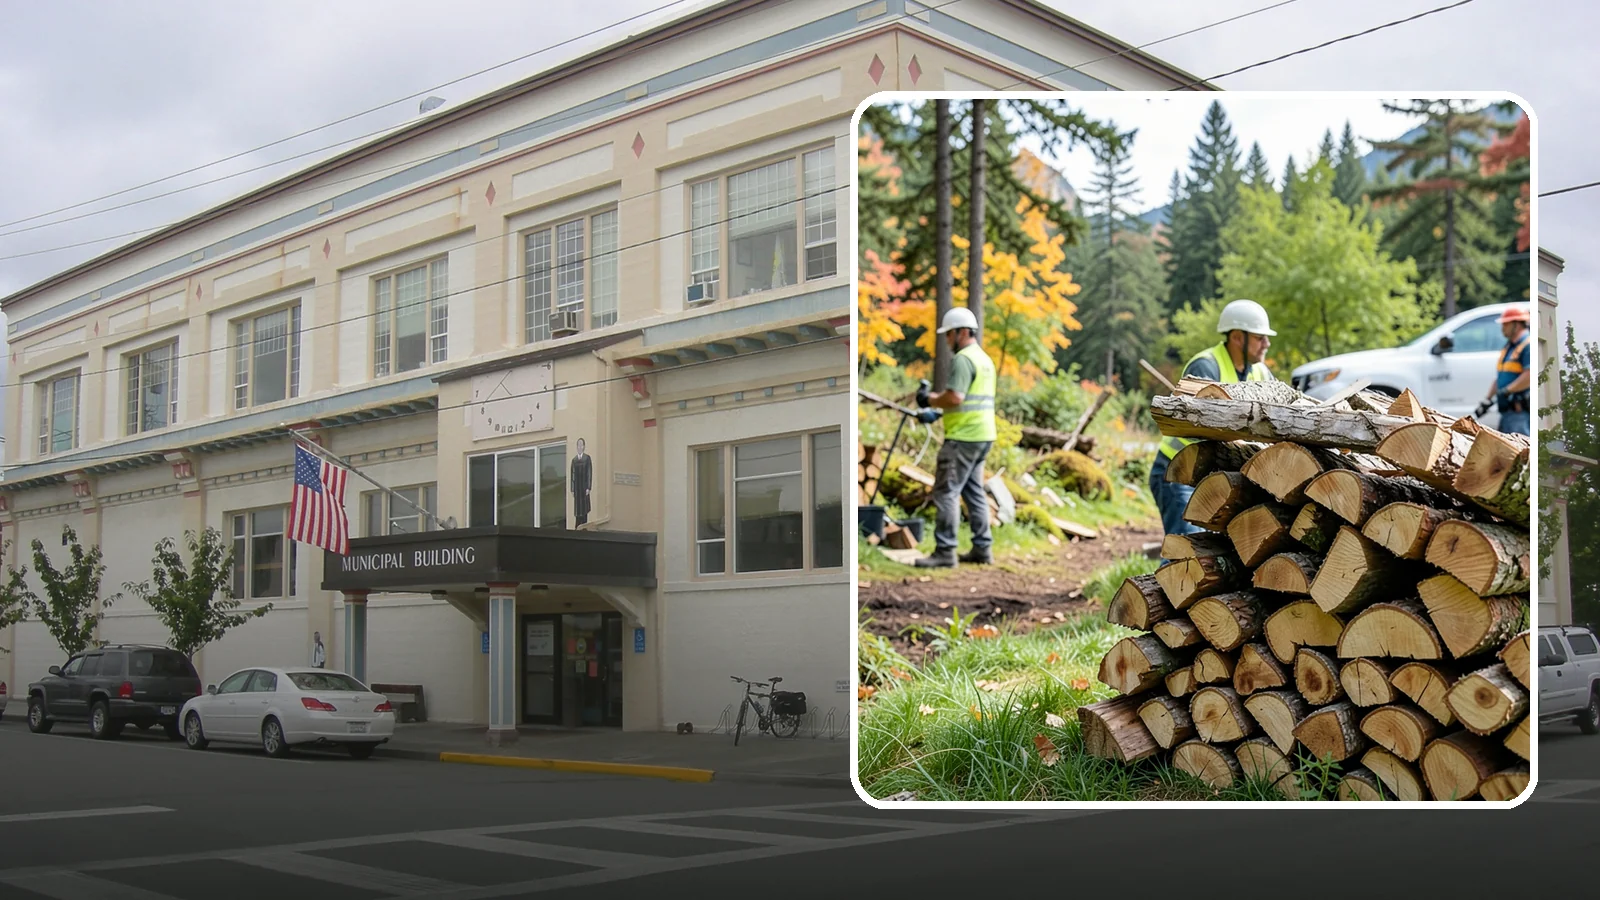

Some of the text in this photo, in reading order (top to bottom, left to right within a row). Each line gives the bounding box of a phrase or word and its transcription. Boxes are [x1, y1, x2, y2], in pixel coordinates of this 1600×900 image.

[536, 402, 540, 410] 4
[481, 407, 485, 415] 8
[487, 417, 492, 425] 9
[529, 414, 533, 422] 3
[494, 423, 500, 431] 10
[521, 420, 525, 428] 2
[507, 425, 513, 433] 12
[342, 546, 475, 572] MUNICIPAL BUILDING
